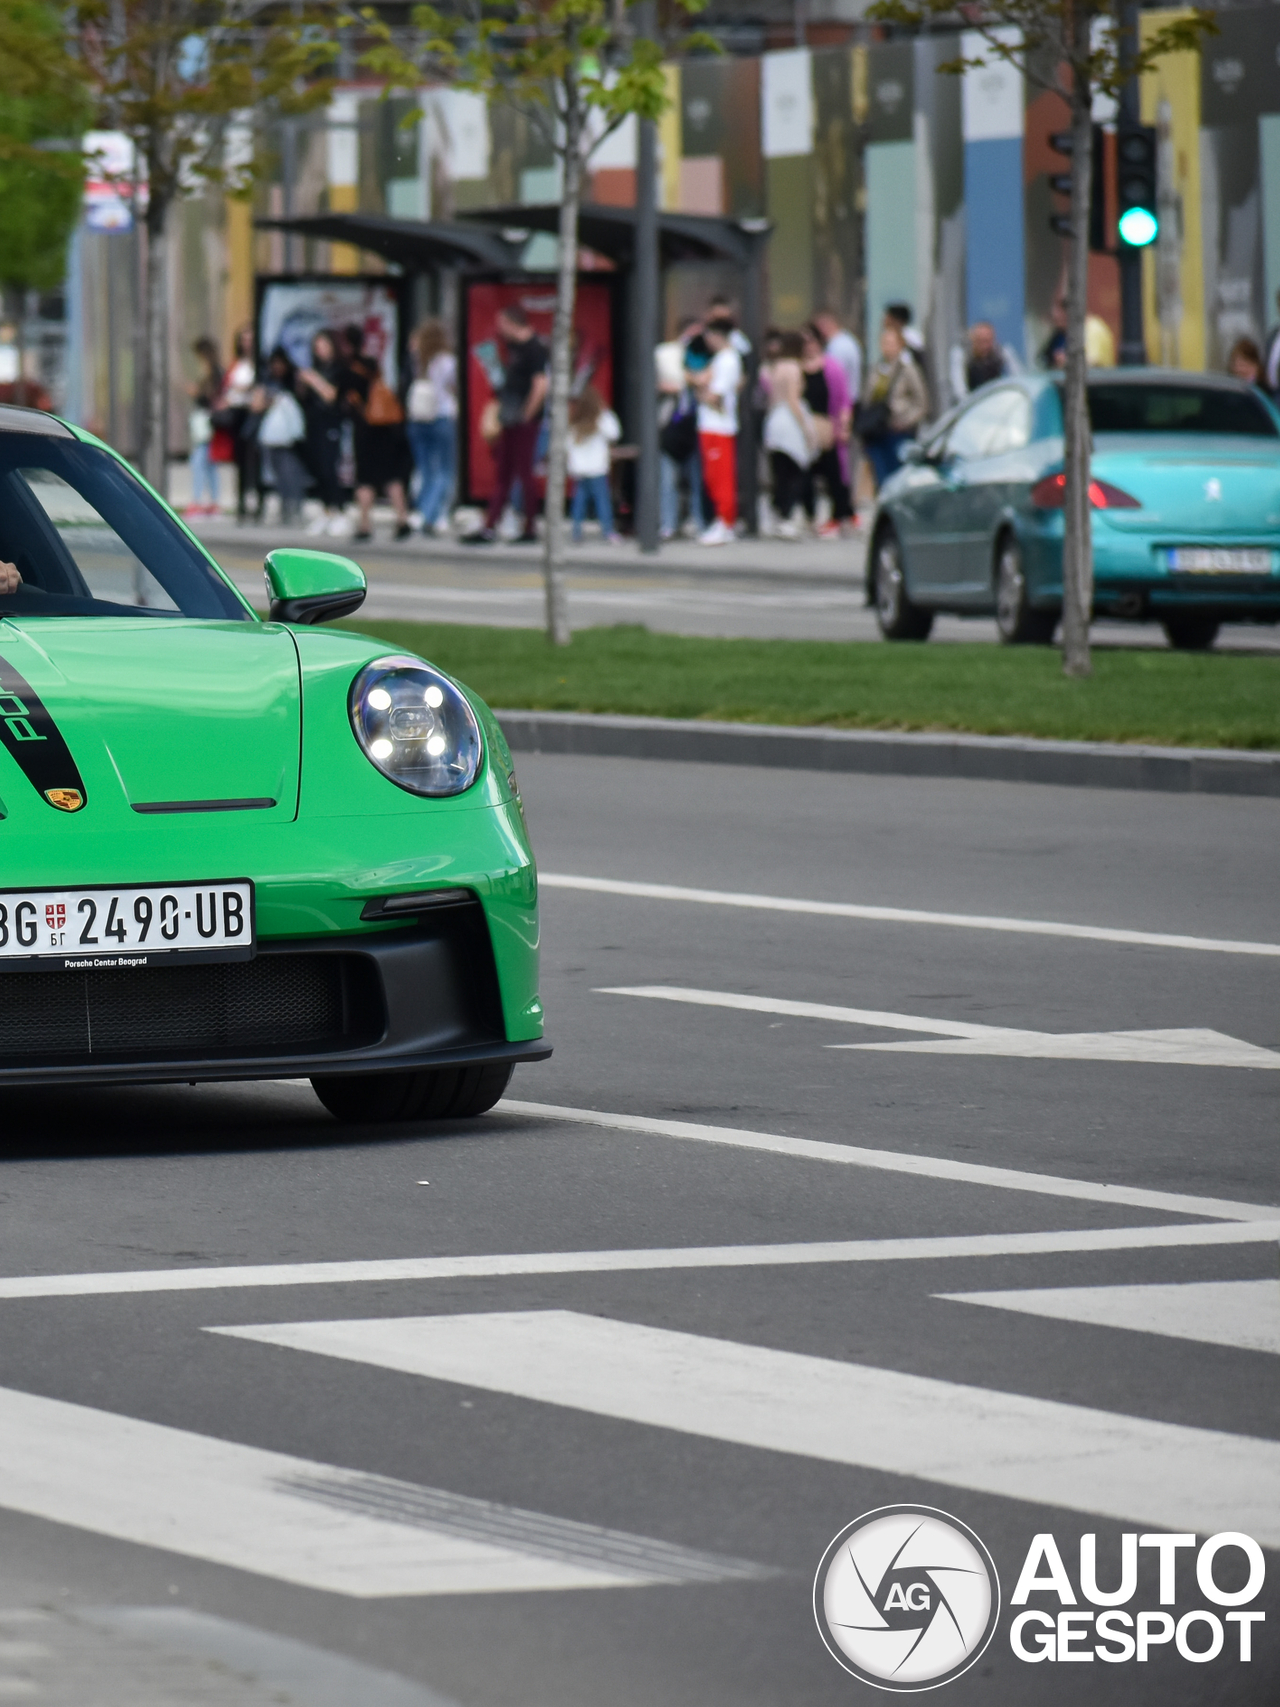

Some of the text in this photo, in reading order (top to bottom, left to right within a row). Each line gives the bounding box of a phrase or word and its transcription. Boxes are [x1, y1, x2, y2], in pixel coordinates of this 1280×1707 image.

[50, 932, 65, 946] БГ
[64, 956, 148, 968] Porsche Centar Beograd
